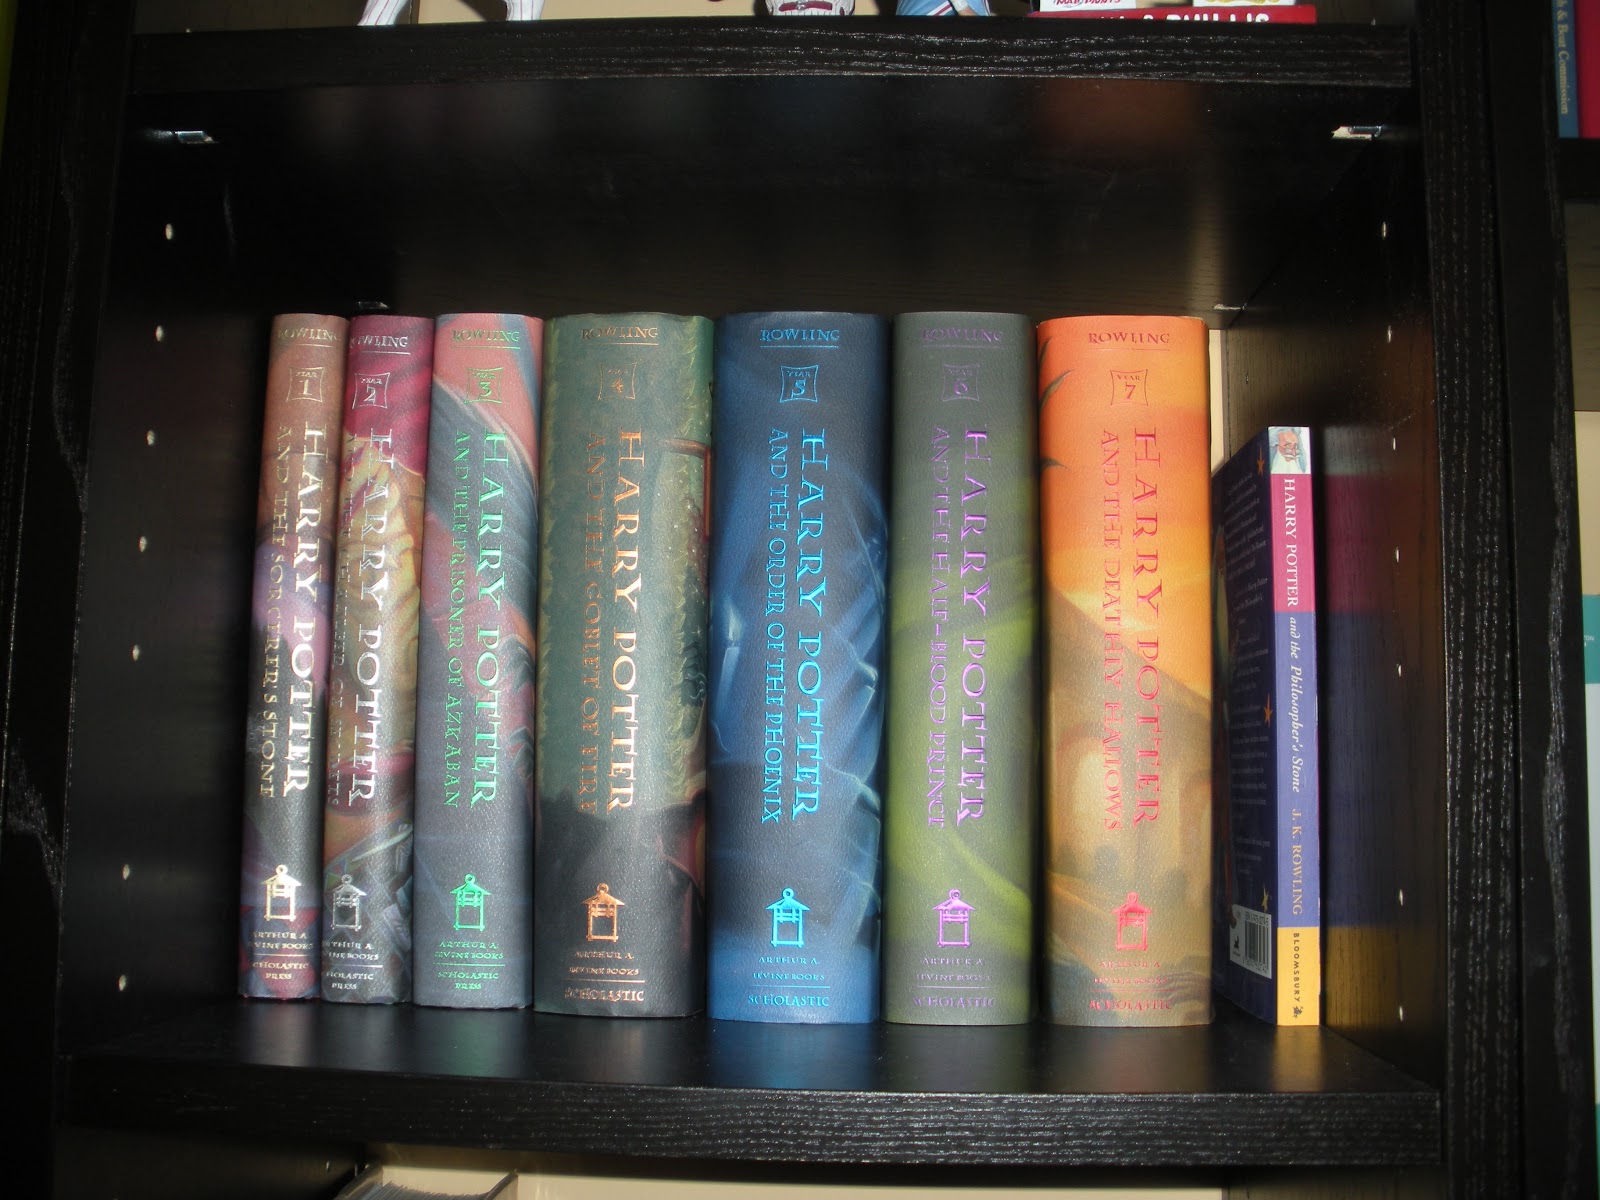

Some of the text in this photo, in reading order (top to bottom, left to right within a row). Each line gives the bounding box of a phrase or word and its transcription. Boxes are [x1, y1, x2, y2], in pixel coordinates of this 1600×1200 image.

[1558, 24, 1568, 47] Boat
[1559, 50, 1570, 114] Commission
[452, 329, 520, 342] ROWLING
[579, 326, 659, 340] ROWLING
[759, 328, 840, 342] ROWLING
[920, 327, 1003, 342] ROWLING
[1088, 331, 1170, 344] ROWLING
[299, 379, 312, 396] 1
[363, 384, 376, 403] 2
[478, 381, 492, 398] 3
[791, 378, 807, 398] 5
[953, 377, 969, 395] 6
[1125, 381, 1136, 400] 7
[1282, 478, 1300, 608] HARRY POTTER
[260, 426, 291, 797] AND THE SORCERER'S STONE
[283, 421, 329, 798] HARRY POTTER
[349, 428, 396, 807] HARRY POTTER
[443, 429, 471, 808] AND THE PRISONER OF AZKABAN
[470, 431, 509, 808] HARRY POTTER
[577, 431, 607, 815] AND THE GOBLET OF FIRE
[606, 431, 645, 816] HARRY POTTER
[761, 428, 790, 824] AND THE ORDER OF THE PHOENIX
[791, 427, 828, 821] HARRY POTTER
[926, 427, 951, 829] AND THE HALF-BLOOD PRINCE
[956, 430, 991, 827] HARRY POTTER
[1101, 429, 1124, 831] AND THE DEATHLY HALLOWS
[1132, 428, 1163, 828] HARRY POTTER
[1289, 616, 1304, 793] and the Philosopher's Stone
[1291, 809, 1303, 915] J. K. ROWLING
[248, 942, 281, 950] VINE
[322, 940, 362, 950] THUR
[439, 941, 487, 949] ARTHUR
[347, 952, 379, 961] BOOKS
[471, 952, 504, 960] BOOKS
[758, 956, 807, 965] ARTHUR
[249, 961, 309, 970] CHOLASTIC
[606, 967, 640, 976] BOOKS
[1292, 933, 1300, 1002] BLOOMSBURY
[265, 972, 293, 980] PRESS
[323, 971, 374, 980] HOLASTIC
[437, 971, 499, 980] SCHOLASTIC
[752, 972, 825, 981] LEVINE BOOKS
[331, 982, 358, 990] PRESS
[455, 982, 482, 990] PRESS
[564, 988, 645, 1002] SCHOLASTIC
[748, 994, 830, 1007] SCHOLASTIC
[912, 996, 995, 1008] SCHOLASTIC
[1089, 999, 1173, 1011] SCHOLASTIC
